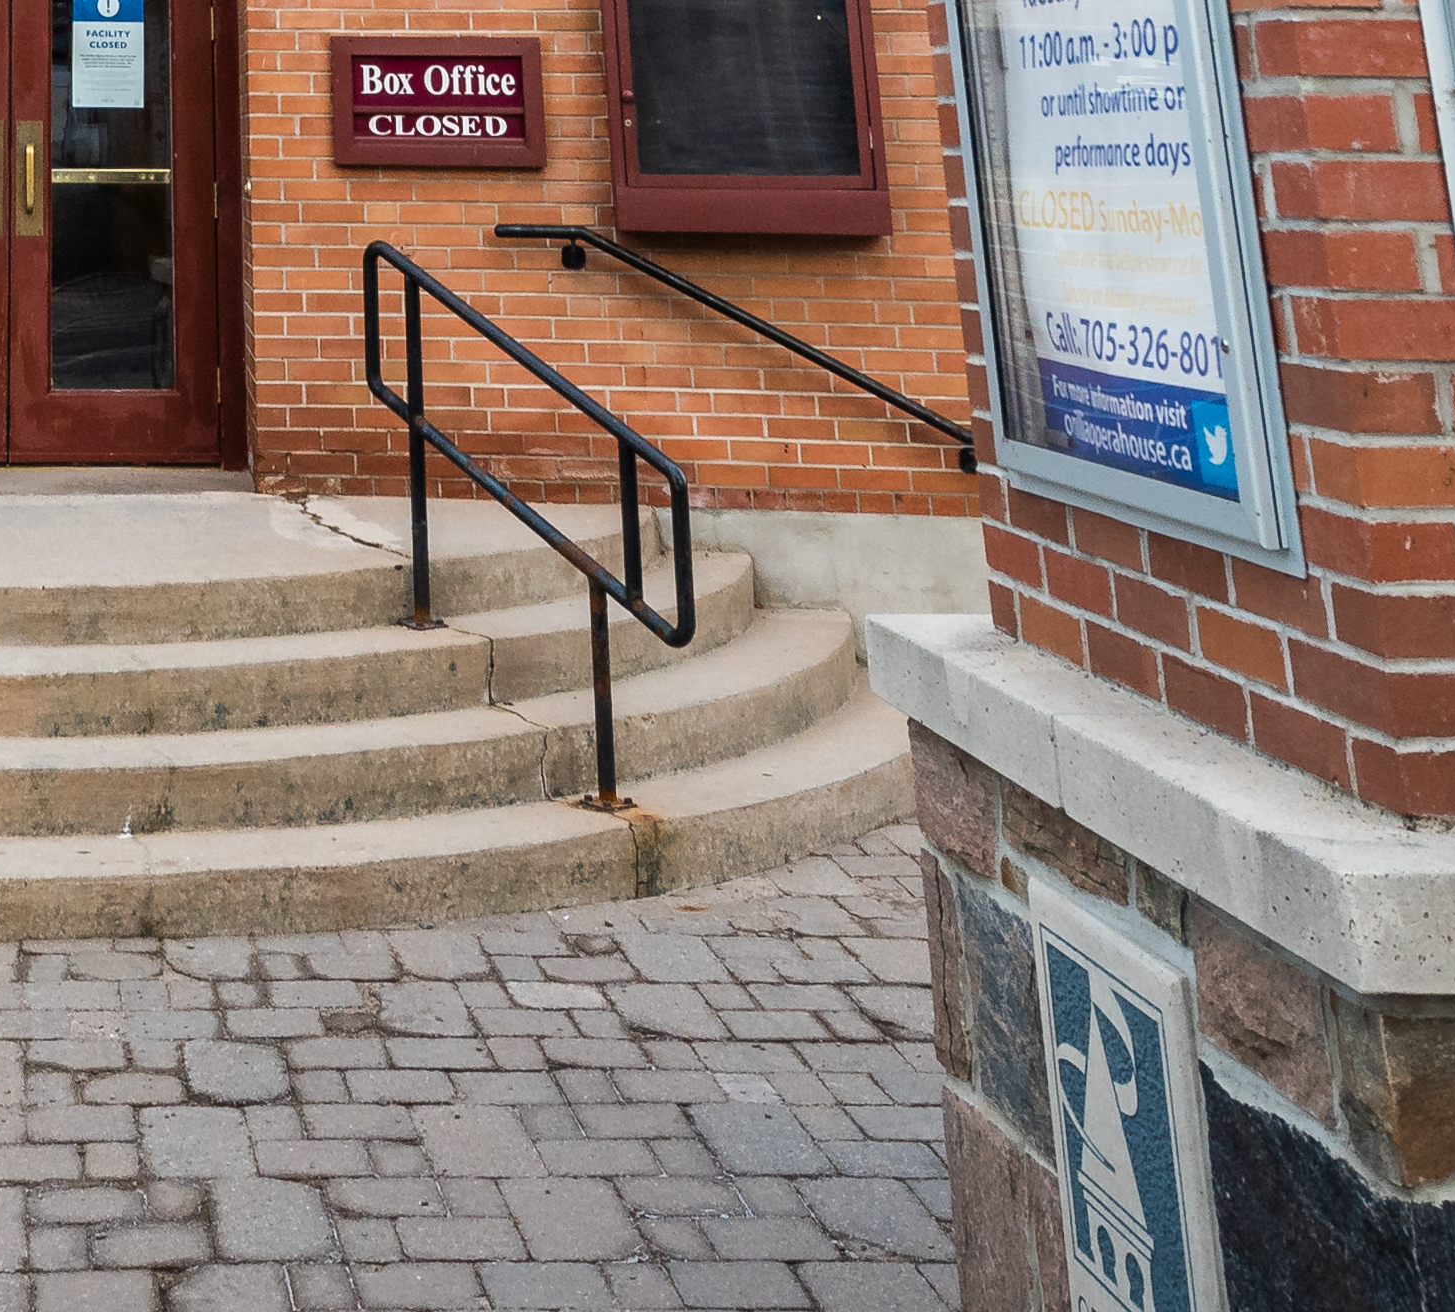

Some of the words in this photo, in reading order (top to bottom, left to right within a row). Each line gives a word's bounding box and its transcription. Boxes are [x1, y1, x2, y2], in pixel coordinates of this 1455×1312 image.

[89, 41, 127, 49] CLOSED
[360, 65, 415, 95] Box
[424, 64, 515, 95] Office
[368, 115, 507, 136] CLOSED
[1055, 134, 1140, 174] performance
[1145, 133, 1191, 175] days
[1046, 312, 1080, 355] Call:
